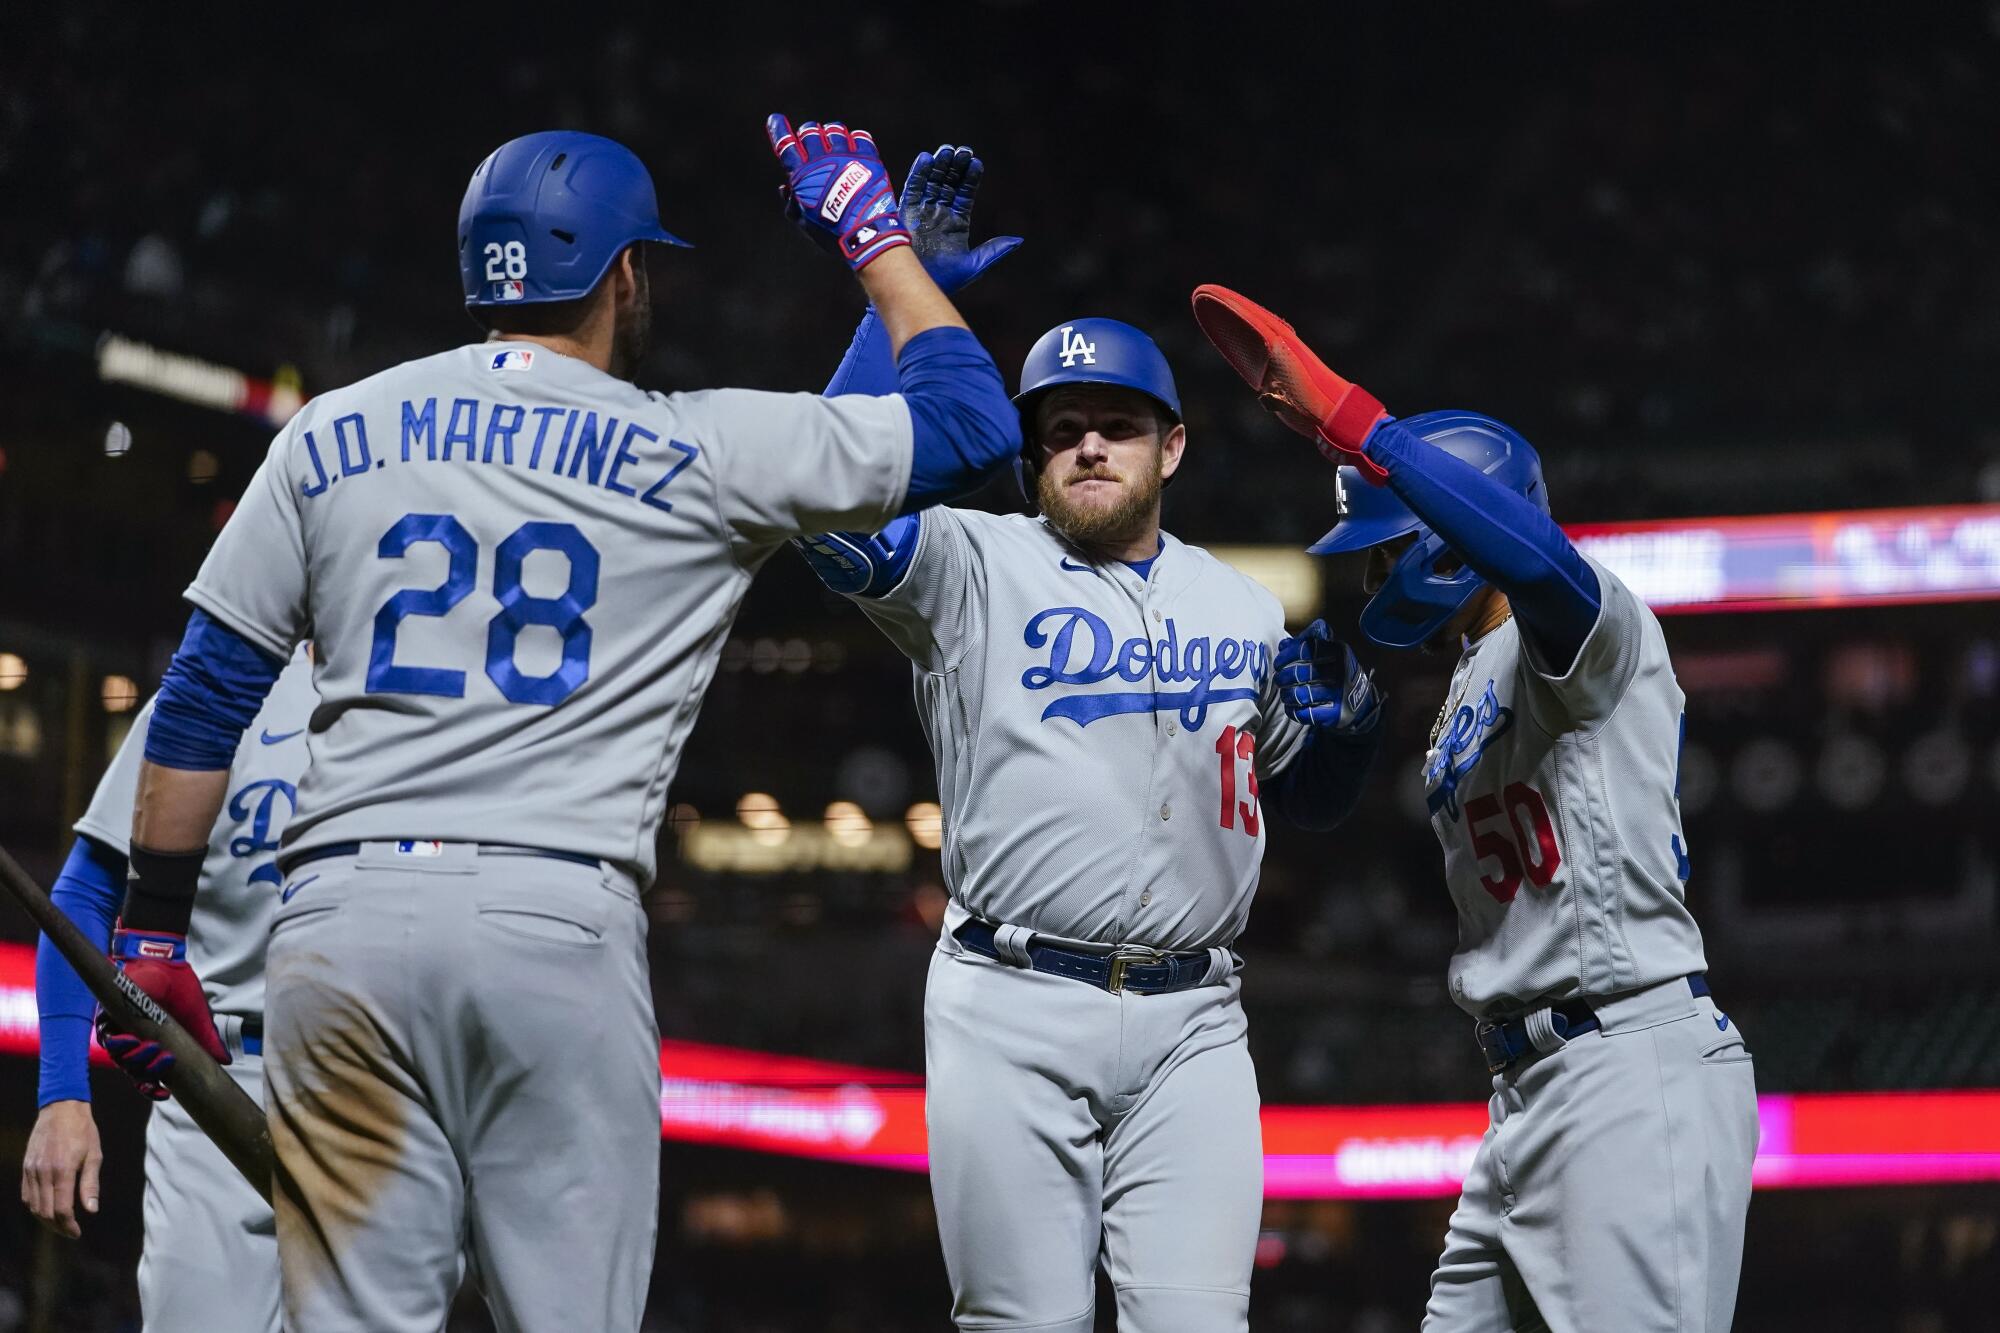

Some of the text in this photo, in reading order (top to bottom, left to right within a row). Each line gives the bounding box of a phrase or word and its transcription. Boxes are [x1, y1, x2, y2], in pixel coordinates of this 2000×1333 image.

[825, 169, 864, 220] Franklin
[484, 241, 528, 280] 28
[1059, 326, 1096, 368] LA
[302, 397, 698, 513] J.D. MARTINEZ
[365, 513, 600, 707] 28
[1215, 724, 1260, 837] 13
[1463, 780, 1562, 905] 50
